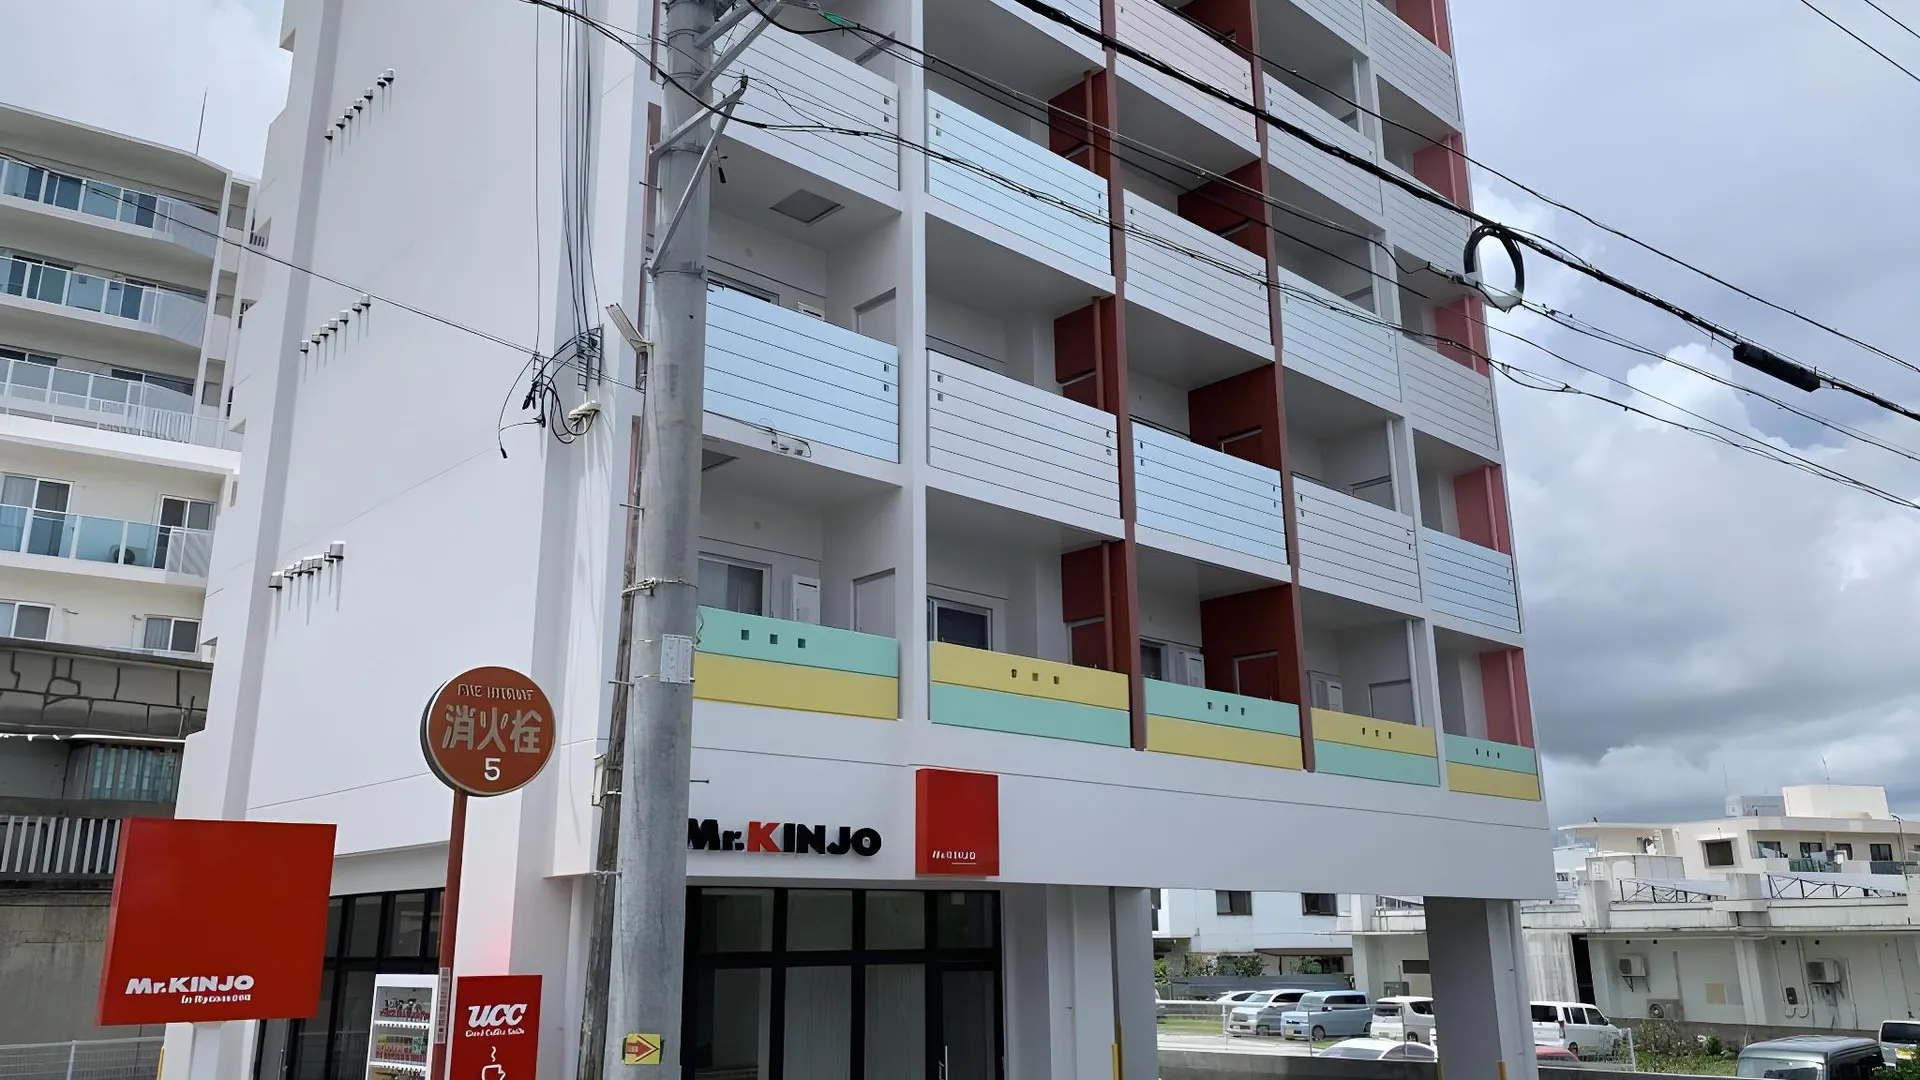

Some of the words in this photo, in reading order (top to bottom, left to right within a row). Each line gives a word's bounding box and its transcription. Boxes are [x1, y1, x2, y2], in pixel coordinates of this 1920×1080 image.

[442, 704, 542, 754] 消火栓
[484, 757, 501, 781] 5
[688, 818, 882, 857] Mr.KINJO
[125, 975, 255, 995] Mr.KINJO
[468, 1003, 528, 1028] UCC
